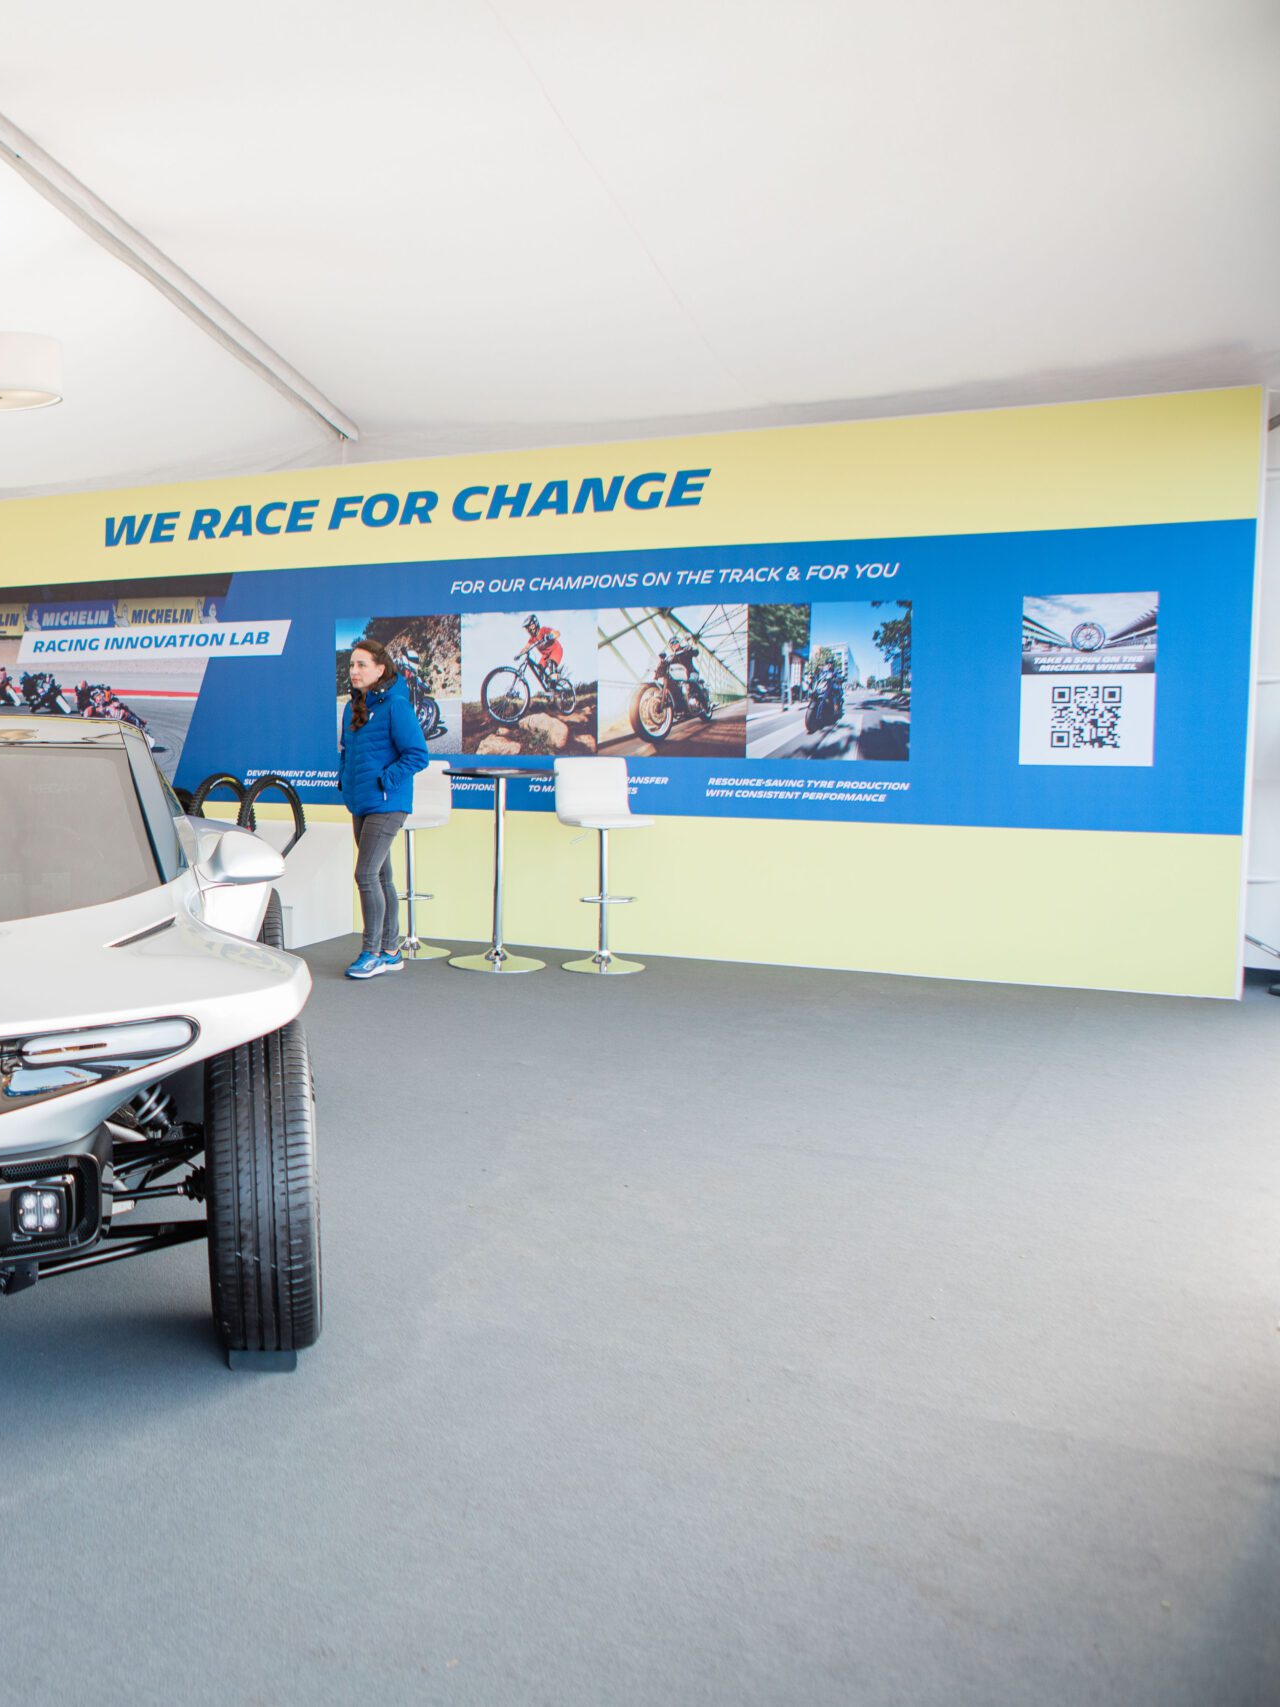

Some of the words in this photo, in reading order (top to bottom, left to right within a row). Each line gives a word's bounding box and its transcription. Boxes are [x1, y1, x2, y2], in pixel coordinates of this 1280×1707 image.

[105, 511, 181, 547] WE
[188, 499, 320, 541] RACE
[327, 490, 439, 531] FOR
[452, 468, 712, 522] CHANGE
[450, 580, 486, 595] FOR
[488, 578, 525, 593] OUR
[528, 573, 639, 591] CHAMPIONS
[642, 571, 671, 587] ON
[676, 569, 714, 585] THE
[719, 566, 784, 584] TRACK
[785, 566, 801, 581] &
[805, 564, 850, 581] FOR
[855, 562, 900, 580] YOU
[41, 609, 110, 626] MICHELIN
[131, 608, 194, 624] MICHELIN
[32, 637, 100, 653] RACING
[104, 633, 225, 650] INNOVATION
[230, 631, 271, 646] LAB
[1033, 656, 1061, 664] TAKE
[1039, 664, 1095, 672] MICHELIN
[305, 770, 317, 778] OF
[449, 783, 496, 792] ONDITIONS
[707, 777, 805, 788] RESOURCE-SAVING
[806, 779, 835, 789] TYRE
[836, 780, 910, 791] PRODUCTION
[705, 789, 733, 798] WITH
[734, 790, 801, 800] CONSISTENT
[801, 791, 887, 803] PERFORMANCE
